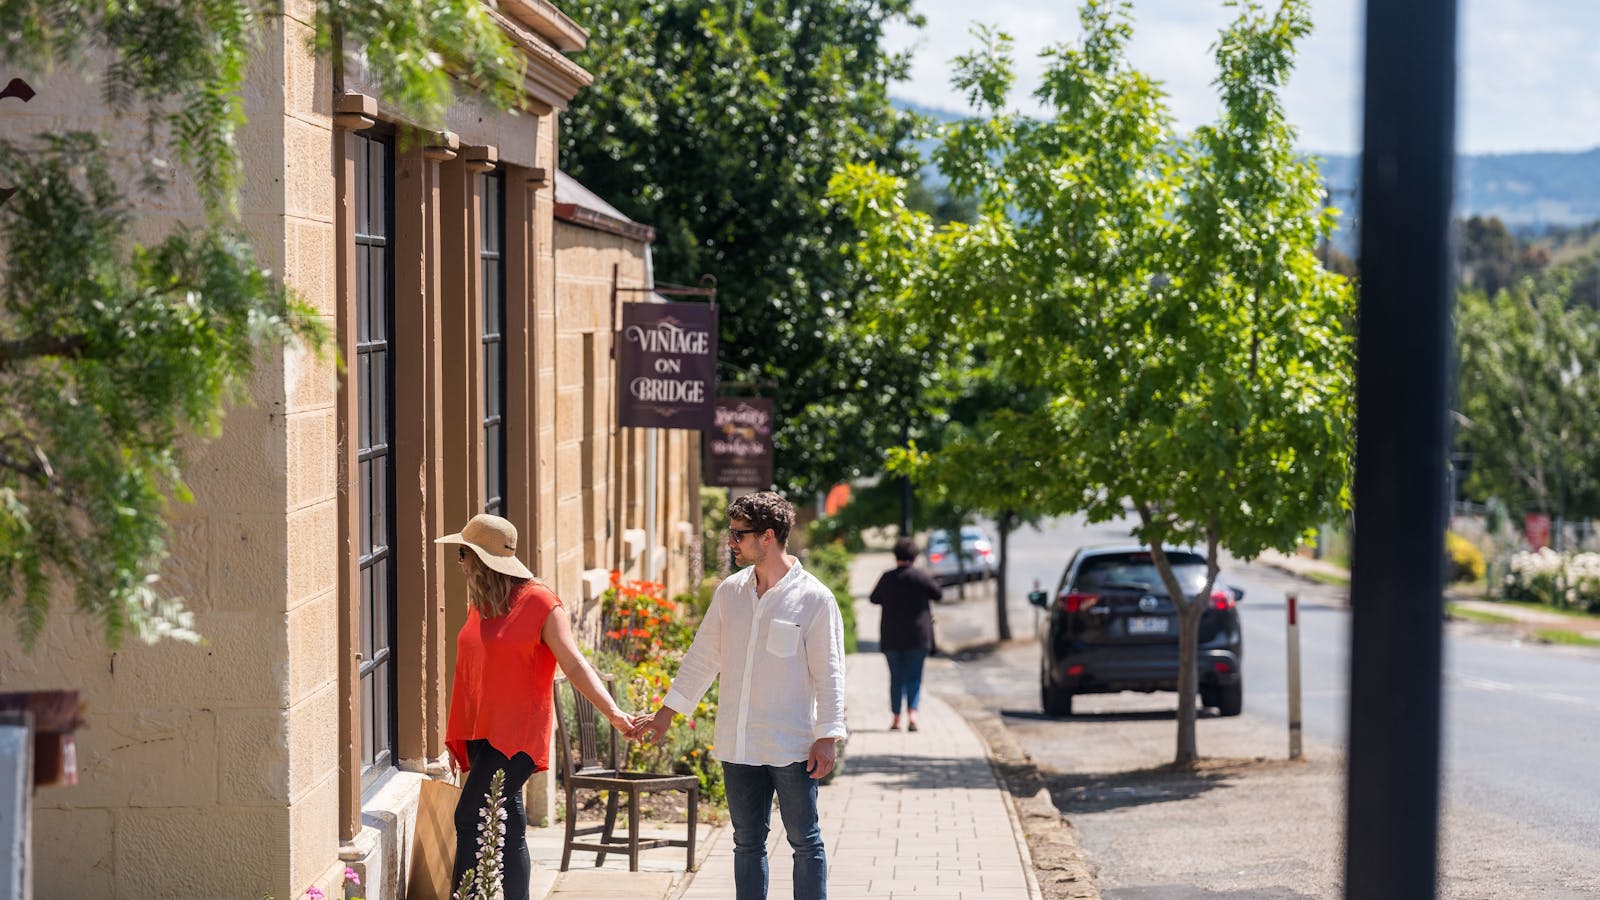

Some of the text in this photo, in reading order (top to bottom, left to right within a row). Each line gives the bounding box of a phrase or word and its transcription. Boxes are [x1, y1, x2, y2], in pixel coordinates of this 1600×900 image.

[625, 322, 709, 354] VINTAGE
[654, 358, 681, 373] ON
[630, 376, 705, 403] BRIDGE
